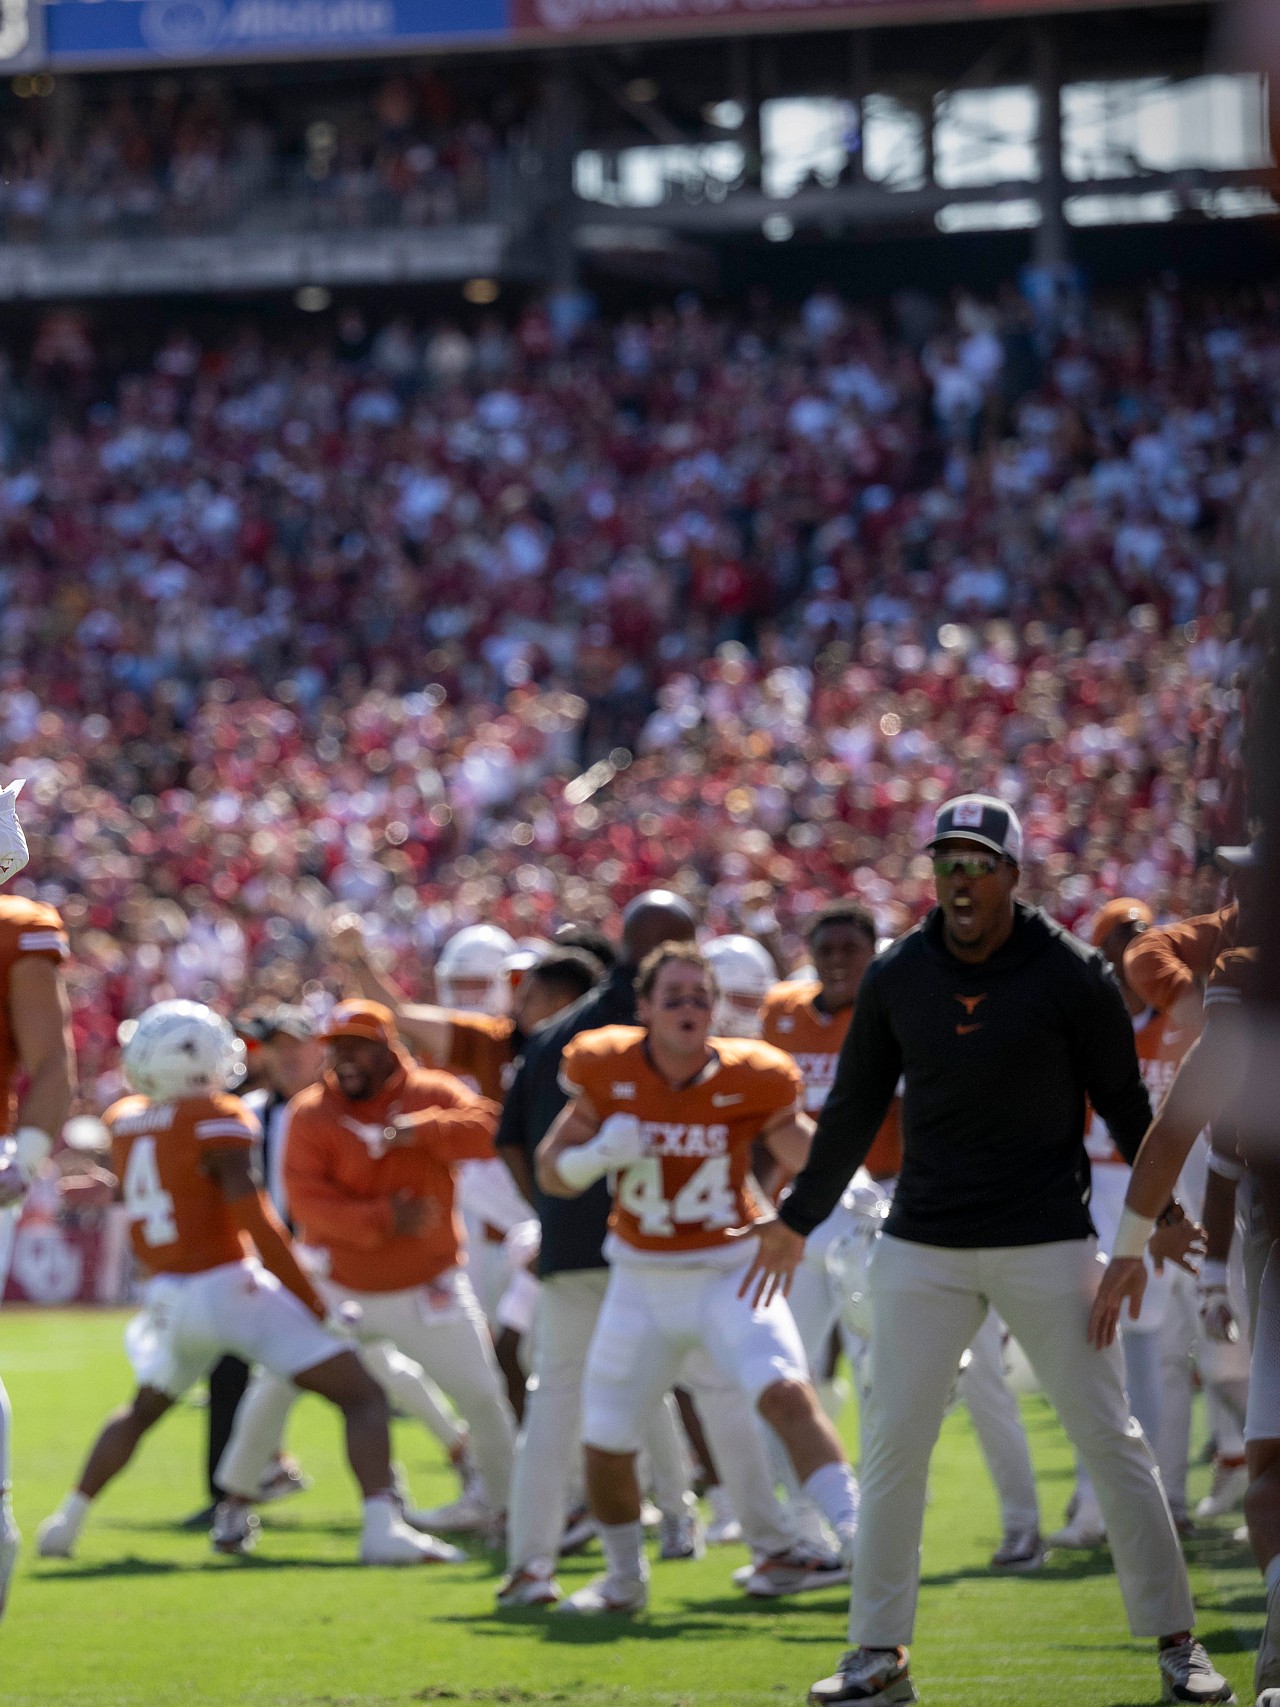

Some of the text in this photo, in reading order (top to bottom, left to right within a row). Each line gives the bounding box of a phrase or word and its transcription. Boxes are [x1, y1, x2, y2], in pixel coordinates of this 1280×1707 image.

[639, 1121, 730, 1157] EXAS
[123, 1135, 179, 1248] 4
[620, 1154, 741, 1238] 44
